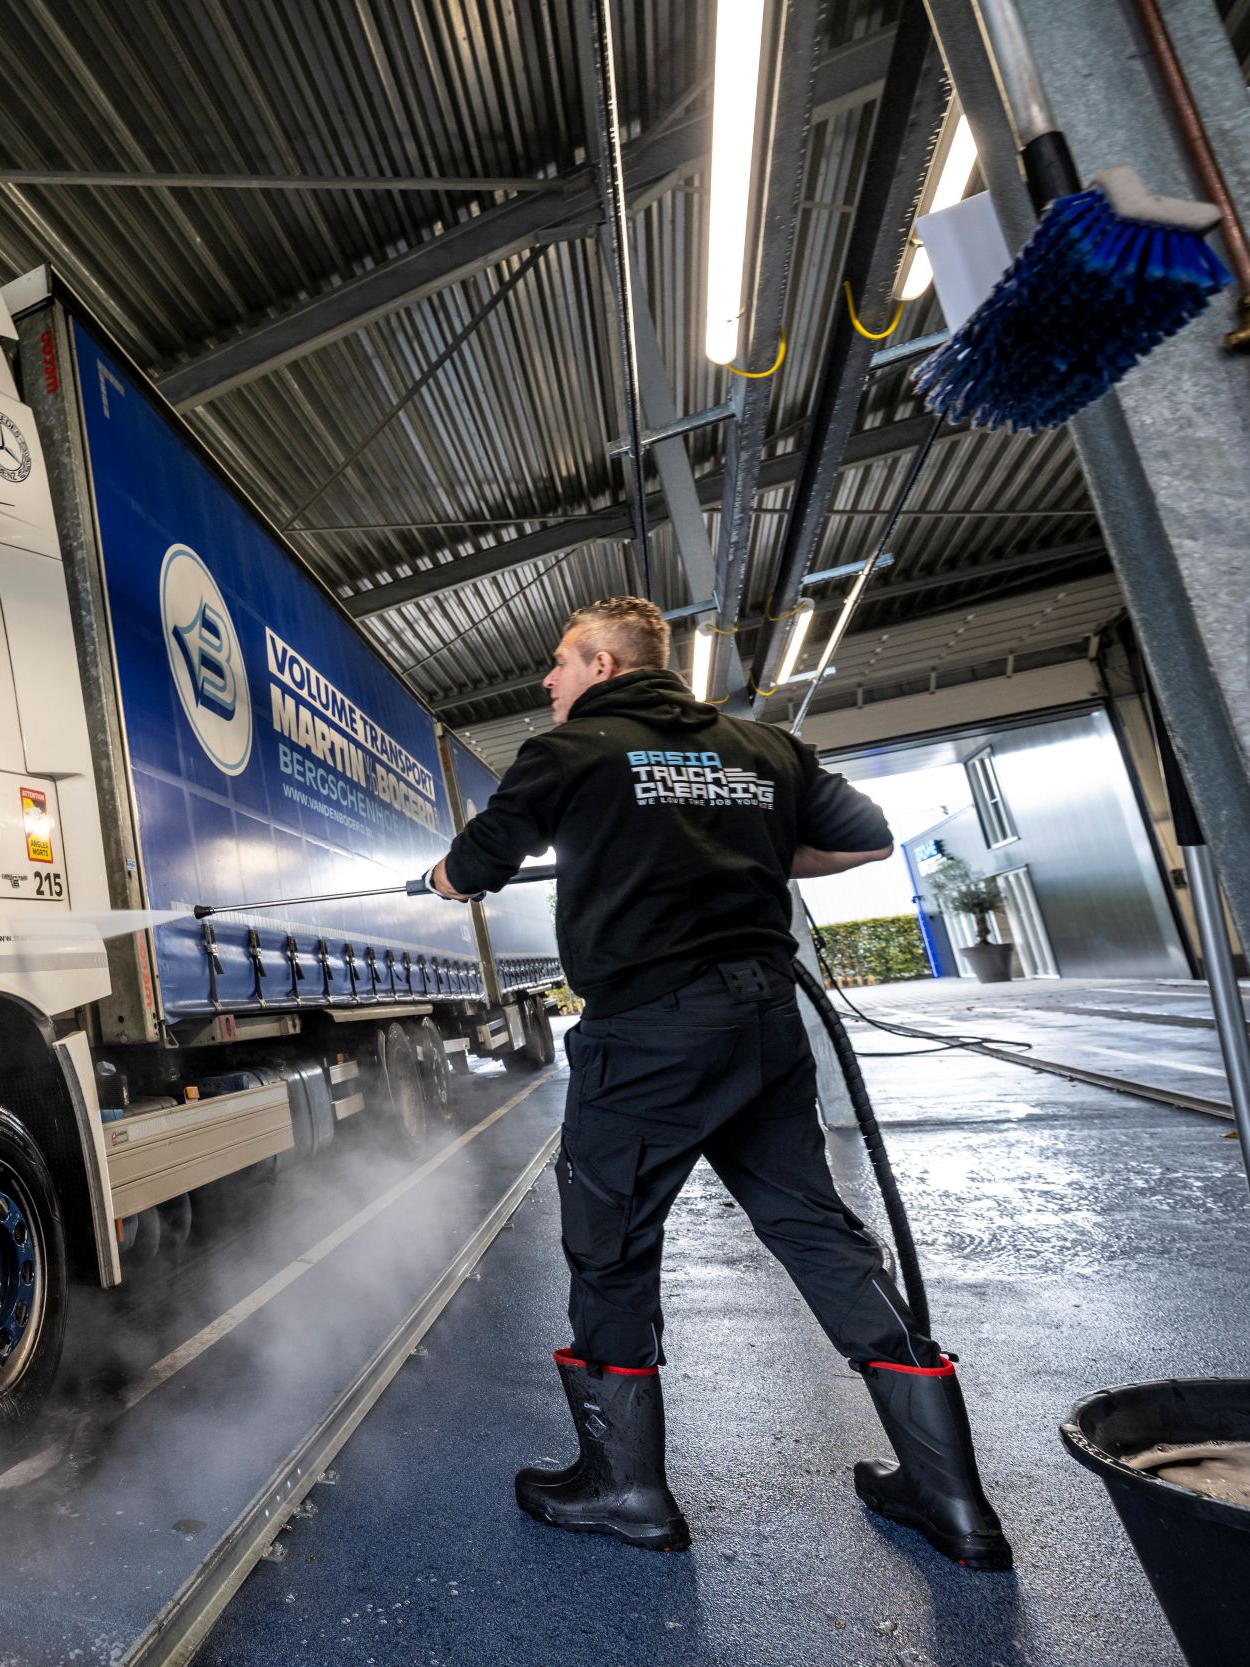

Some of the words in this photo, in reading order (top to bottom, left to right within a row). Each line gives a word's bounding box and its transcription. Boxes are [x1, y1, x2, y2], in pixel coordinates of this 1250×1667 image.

[269, 630, 358, 737] VOLUME
[359, 712, 435, 799] TRANSPORT
[270, 681, 367, 788] MARTIN
[375, 762, 436, 834] BOGERD
[631, 765, 728, 786] TRUCK
[22, 790, 44, 800] ATTENTION
[634, 782, 774, 802] CLEANING
[31, 840, 48, 849] ANGLES
[33, 848, 48, 857] MORTS
[33, 870, 63, 898] 215
